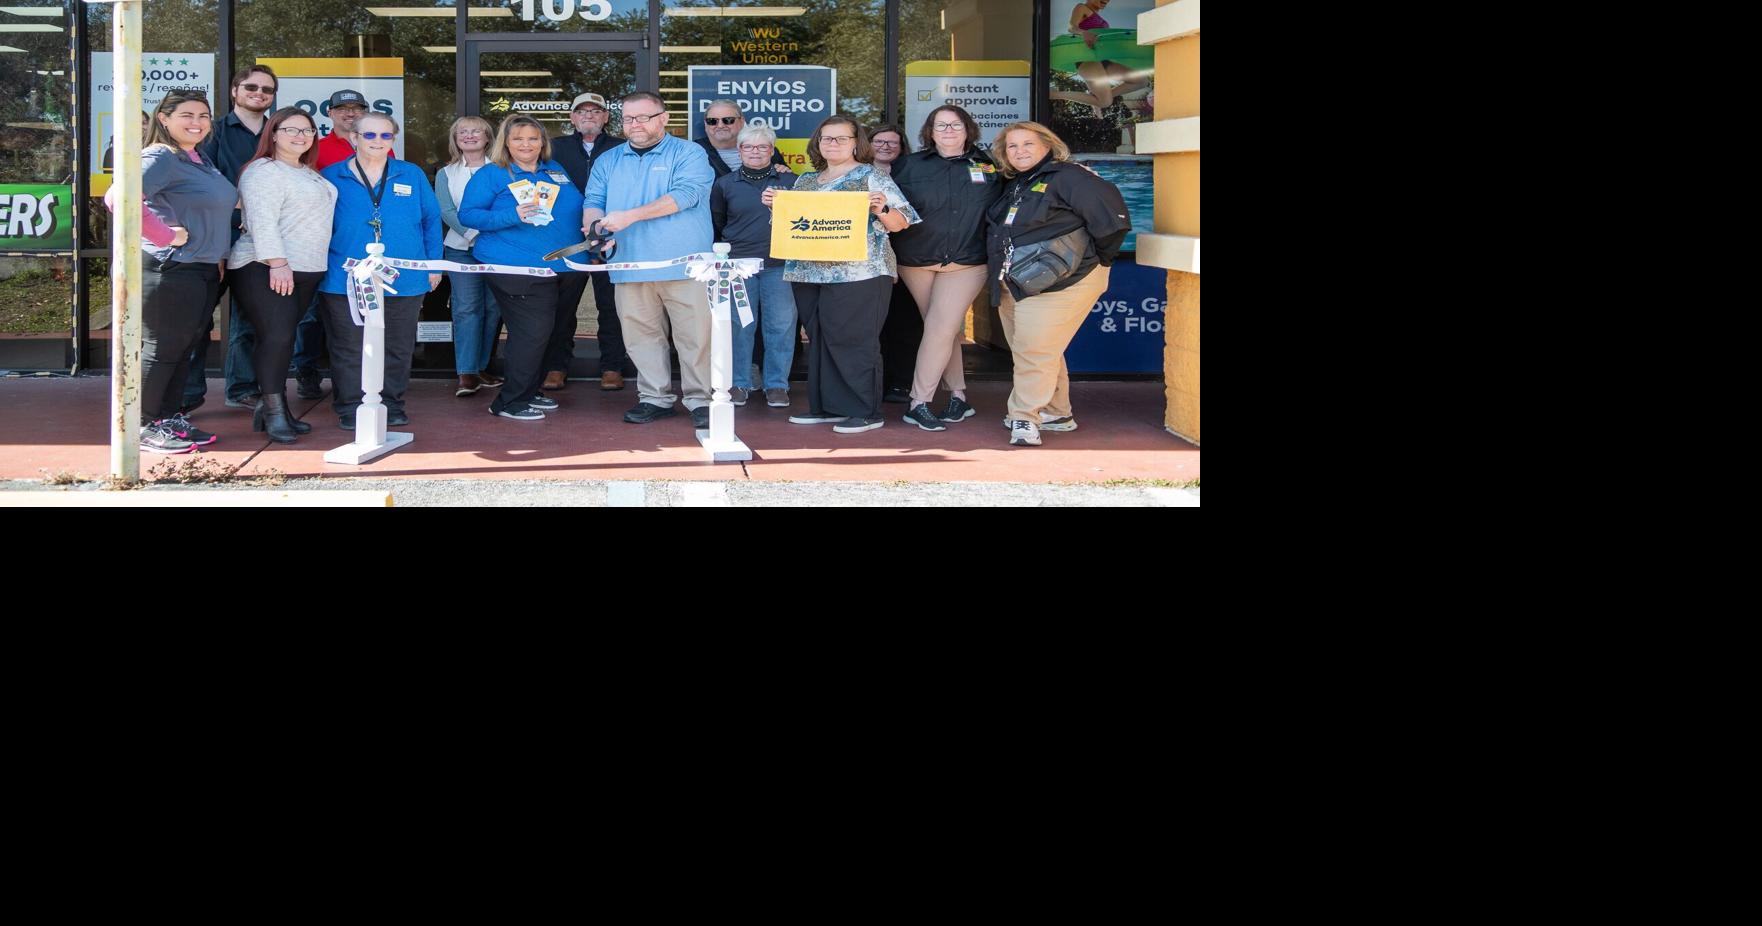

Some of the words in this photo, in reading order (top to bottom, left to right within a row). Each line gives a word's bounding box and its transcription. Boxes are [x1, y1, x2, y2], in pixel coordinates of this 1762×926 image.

[511, 0, 612, 21] 105
[731, 41, 798, 51] Western
[742, 53, 788, 64] Union
[717, 77, 806, 95] ENVÍOS
[945, 84, 999, 94] Instant
[739, 98, 825, 113] DINERO
[944, 96, 1018, 108] approvals
[1091, 300, 1134, 316] oys,
[1100, 317, 1118, 333] &
[1124, 316, 1166, 333] Flo
